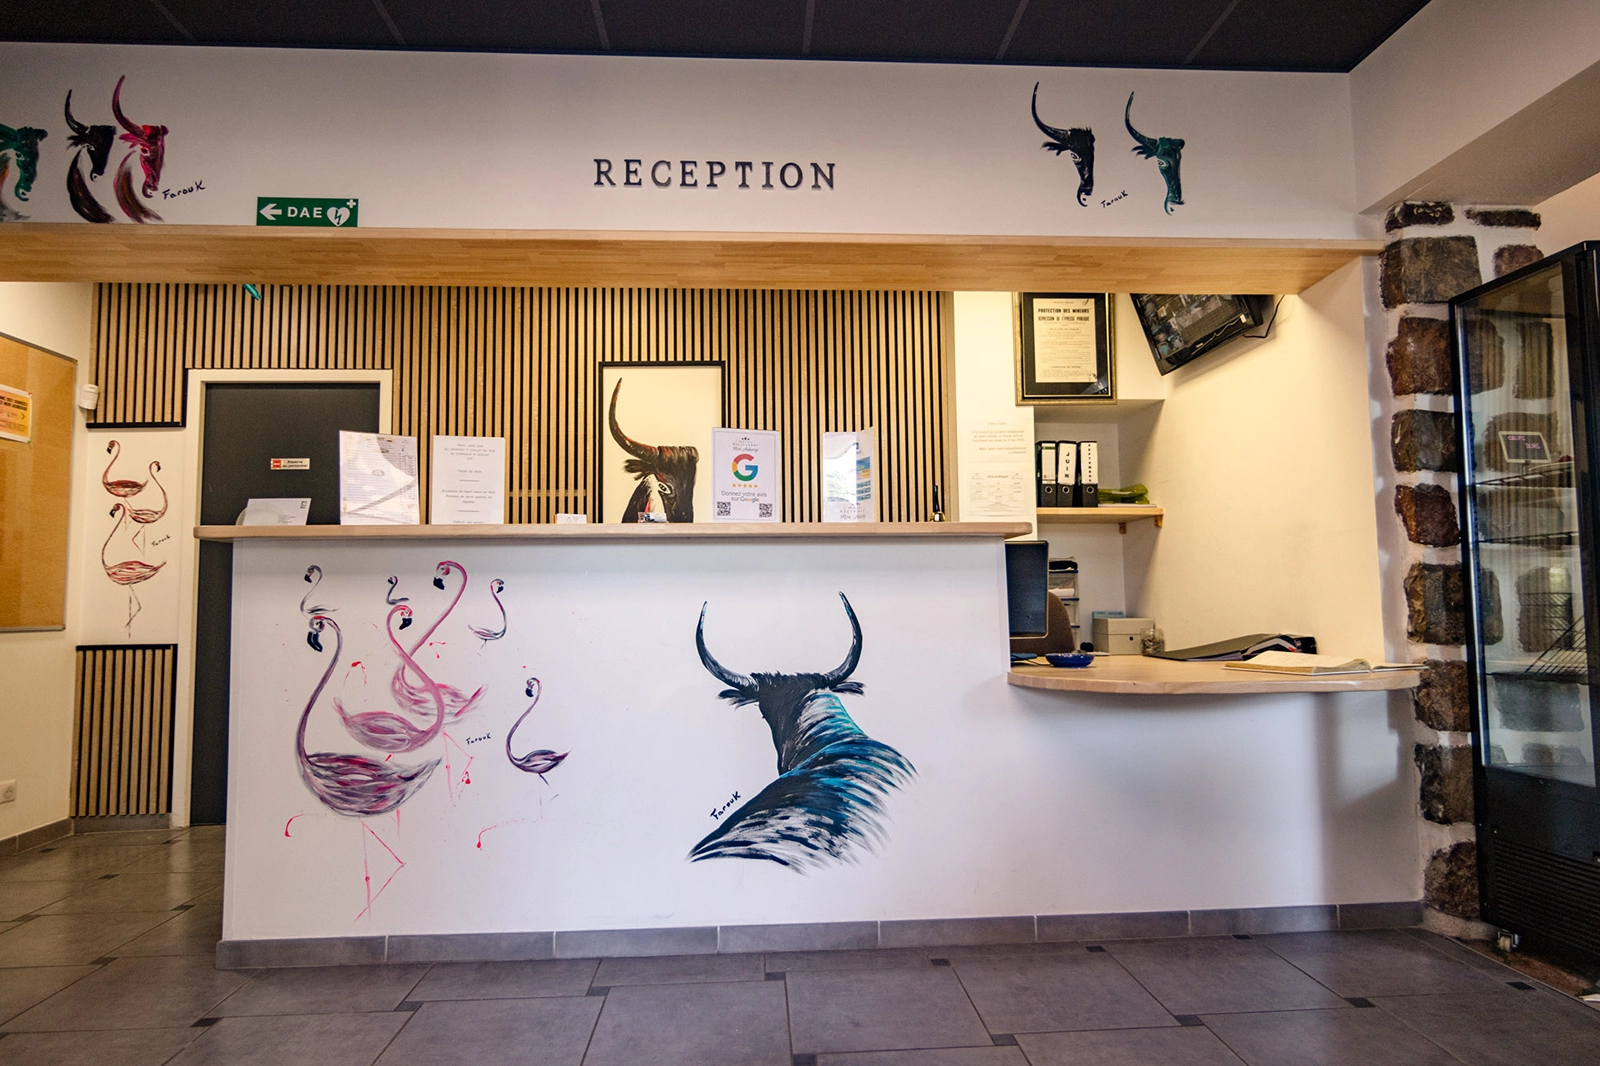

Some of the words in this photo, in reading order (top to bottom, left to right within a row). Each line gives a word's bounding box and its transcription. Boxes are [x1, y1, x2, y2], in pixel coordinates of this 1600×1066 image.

[593, 158, 836, 190] RECEPTION
[287, 206, 323, 218] DAE
[740, 495, 759, 503] Google
